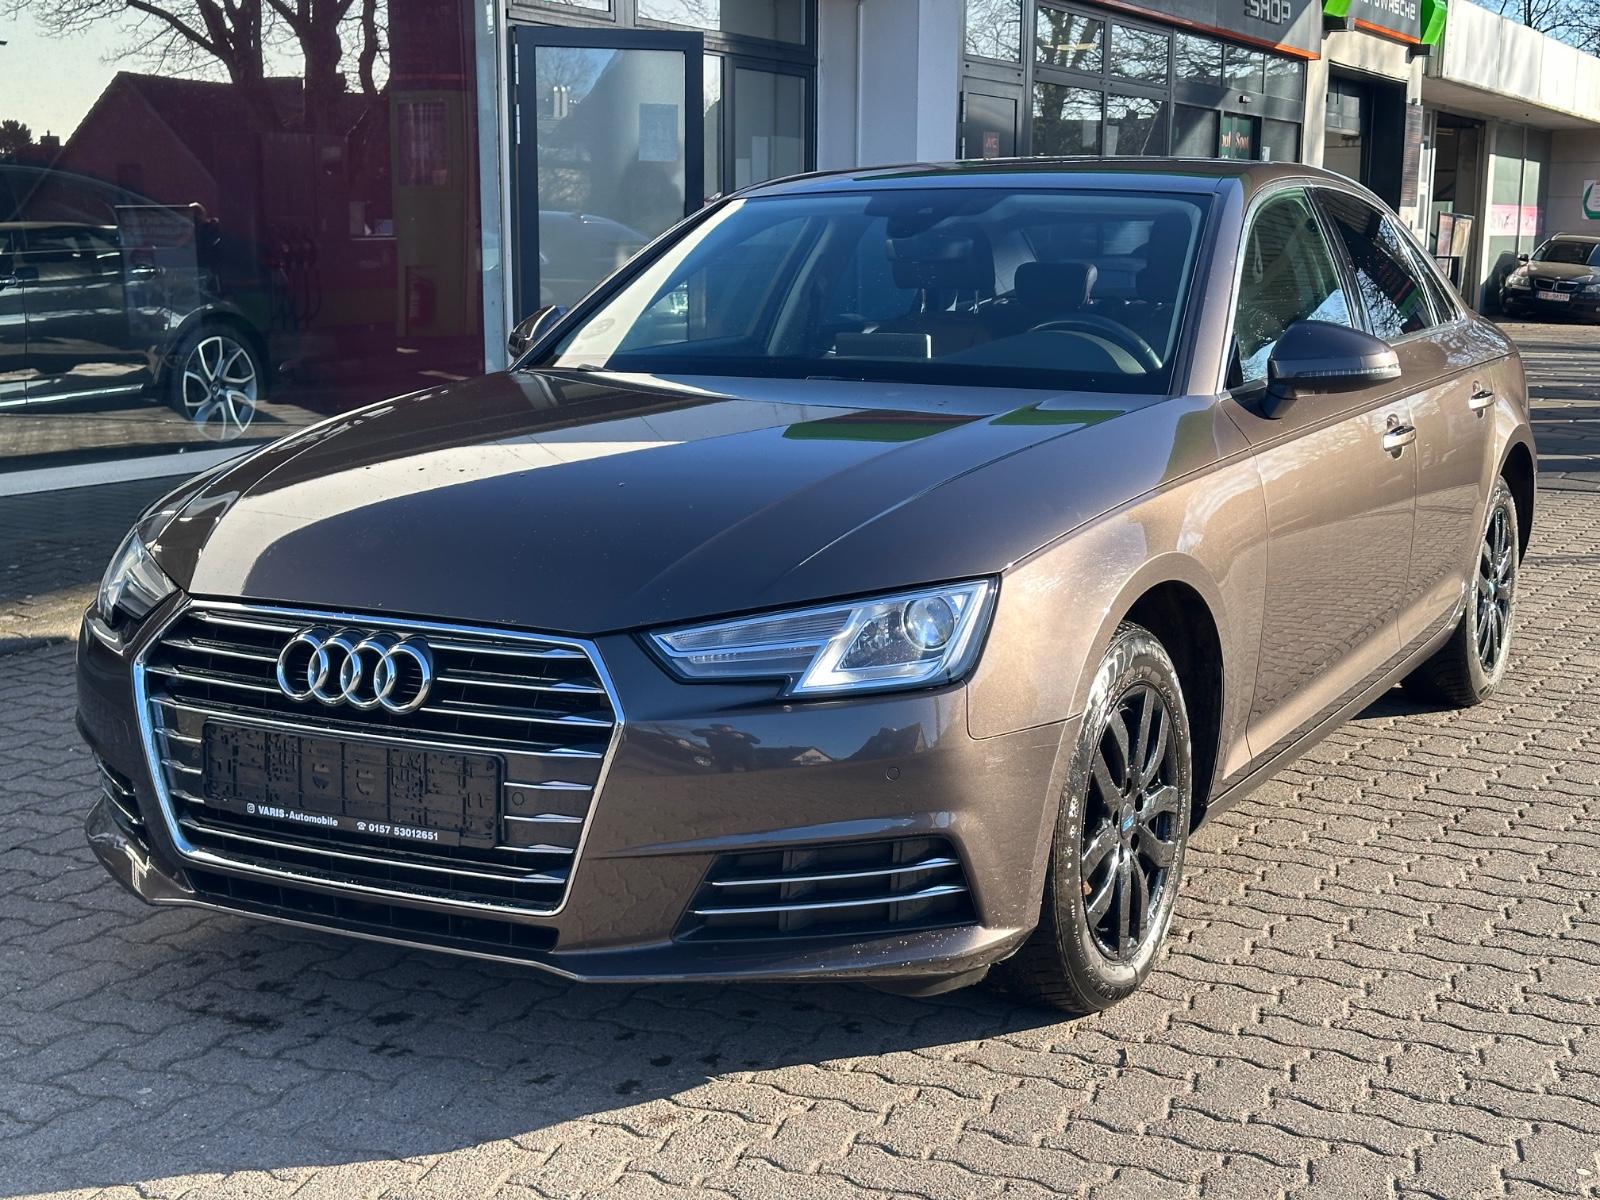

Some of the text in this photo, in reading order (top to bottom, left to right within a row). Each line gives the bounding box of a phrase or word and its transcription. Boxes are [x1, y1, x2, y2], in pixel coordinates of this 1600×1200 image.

[1249, 0, 1291, 24] SHOP
[1359, 0, 1416, 20] WASCHE
[368, 823, 391, 834] 0157
[393, 827, 438, 841] 53012651
